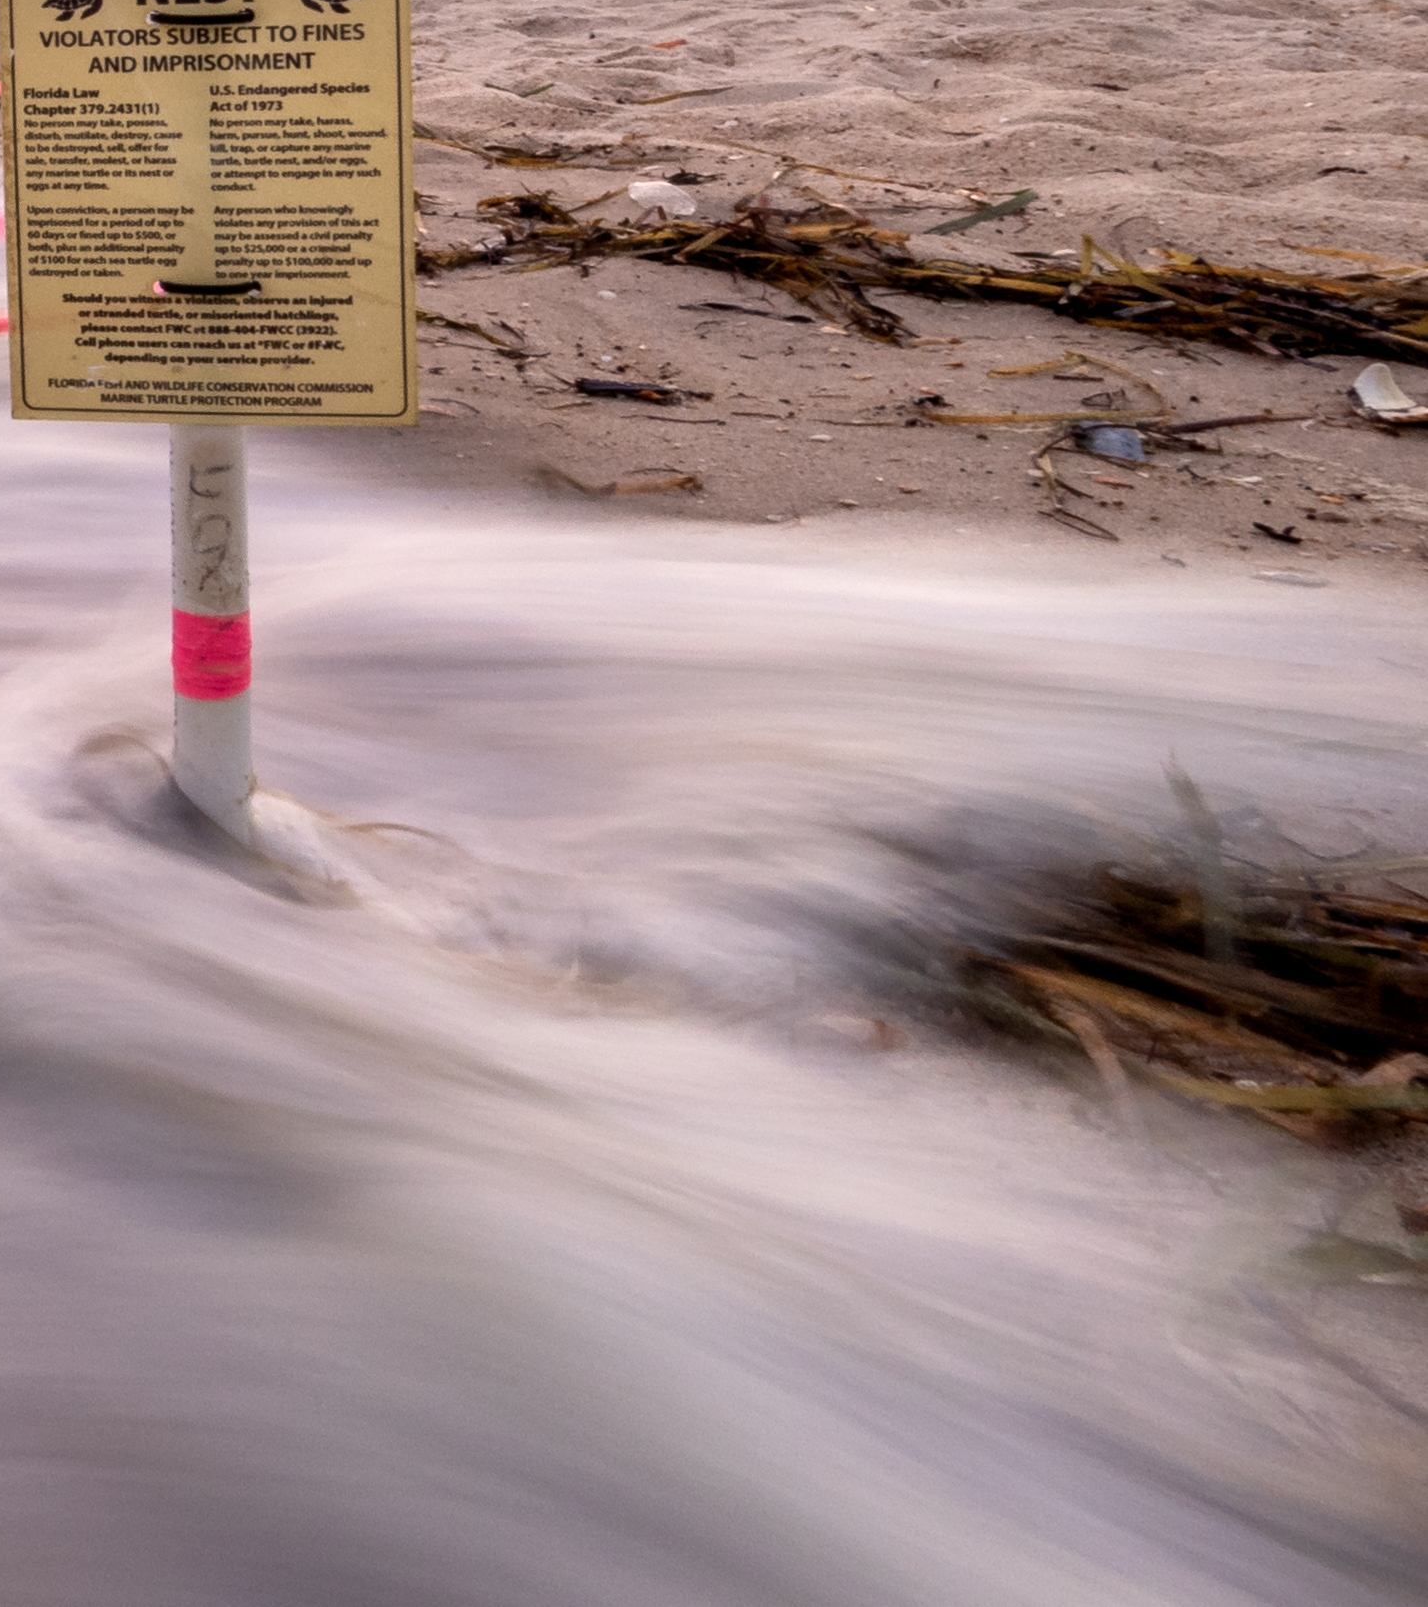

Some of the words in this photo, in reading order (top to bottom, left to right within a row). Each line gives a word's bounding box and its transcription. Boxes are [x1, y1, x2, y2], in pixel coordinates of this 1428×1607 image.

[40, 28, 161, 48] VIOLATORS
[165, 26, 261, 45] SUBJECT
[266, 25, 297, 42] TO
[303, 23, 365, 42] FINES
[89, 54, 137, 73] AND
[143, 51, 316, 72] IMPRISONMENT
[23, 88, 70, 99] Florida
[73, 88, 99, 98] Law
[210, 85, 235, 95] U.S.
[238, 84, 318, 98] Endangered
[320, 83, 370, 97] Species
[24, 104, 77, 118] Chapter
[80, 104, 160, 116] 379.2431(1)
[210, 102, 232, 111] Act
[234, 101, 249, 111] of
[252, 101, 283, 111] 1973
[63, 294, 102, 303] Should
[105, 297, 126, 306] you
[130, 294, 172, 304] witness
[243, 295, 289, 304] observe
[310, 295, 352, 307] injured
[94, 309, 145, 318] stranded
[201, 309, 272, 319] misoriented
[81, 323, 118, 335] please
[120, 323, 163, 333] contact
[166, 324, 192, 333] FWC
[75, 337, 97, 347] Cell
[99, 338, 135, 350] phone
[193, 339, 226, 348] reach
[244, 340, 256, 349] at
[105, 353, 168, 365] depending
[187, 356, 214, 366] your
[217, 354, 258, 364] service
[125, 380, 150, 390] AND
[152, 380, 204, 391] WILDLIFE
[207, 381, 295, 392] CONSERVATION
[298, 382, 373, 393] COMMISSION
[101, 393, 144, 404] MARINE
[146, 394, 188, 404] TURTLE
[190, 394, 262, 405] PROTECTION
[264, 396, 322, 406] PROGRAM
